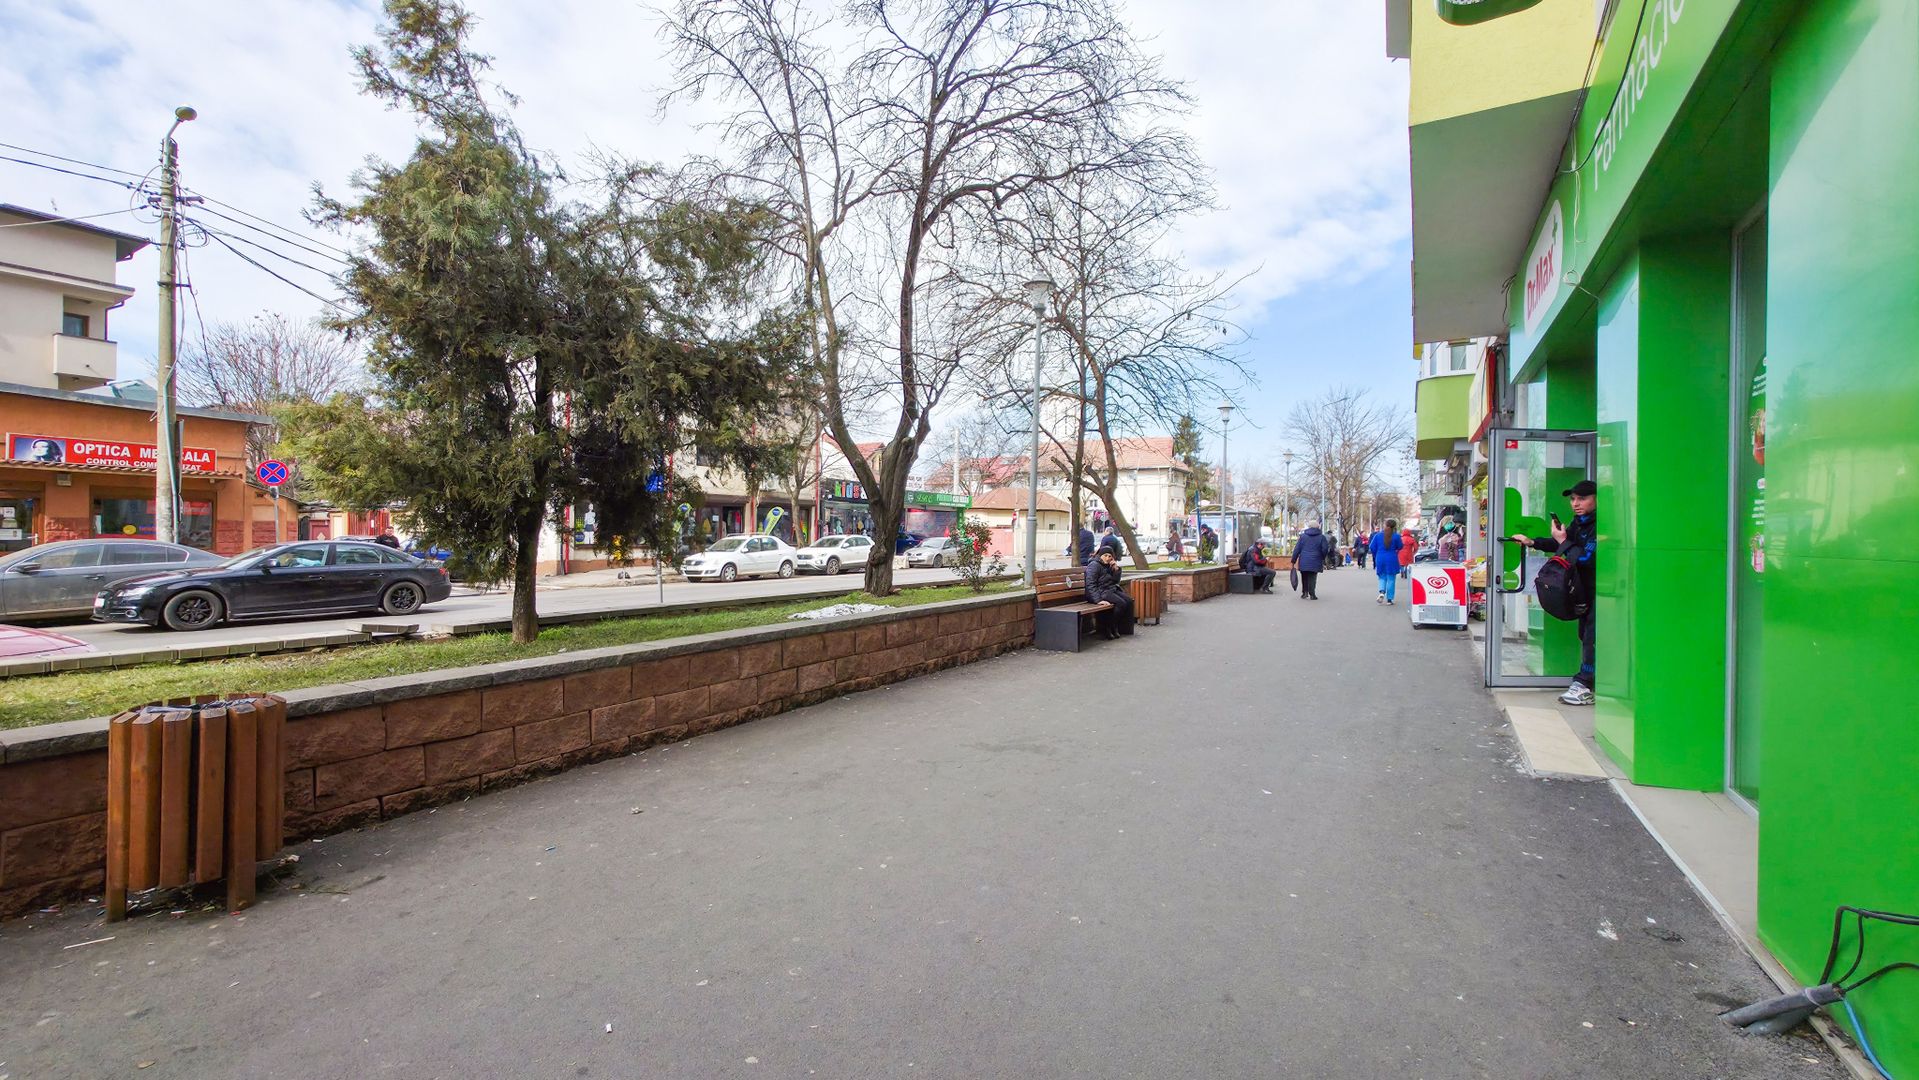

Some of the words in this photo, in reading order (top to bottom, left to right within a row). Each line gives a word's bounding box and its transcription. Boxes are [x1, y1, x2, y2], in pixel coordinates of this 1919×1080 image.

[73, 442, 131, 458] OPTICA
[139, 447, 211, 463] MEALA
[86, 458, 131, 466] CONTROL
